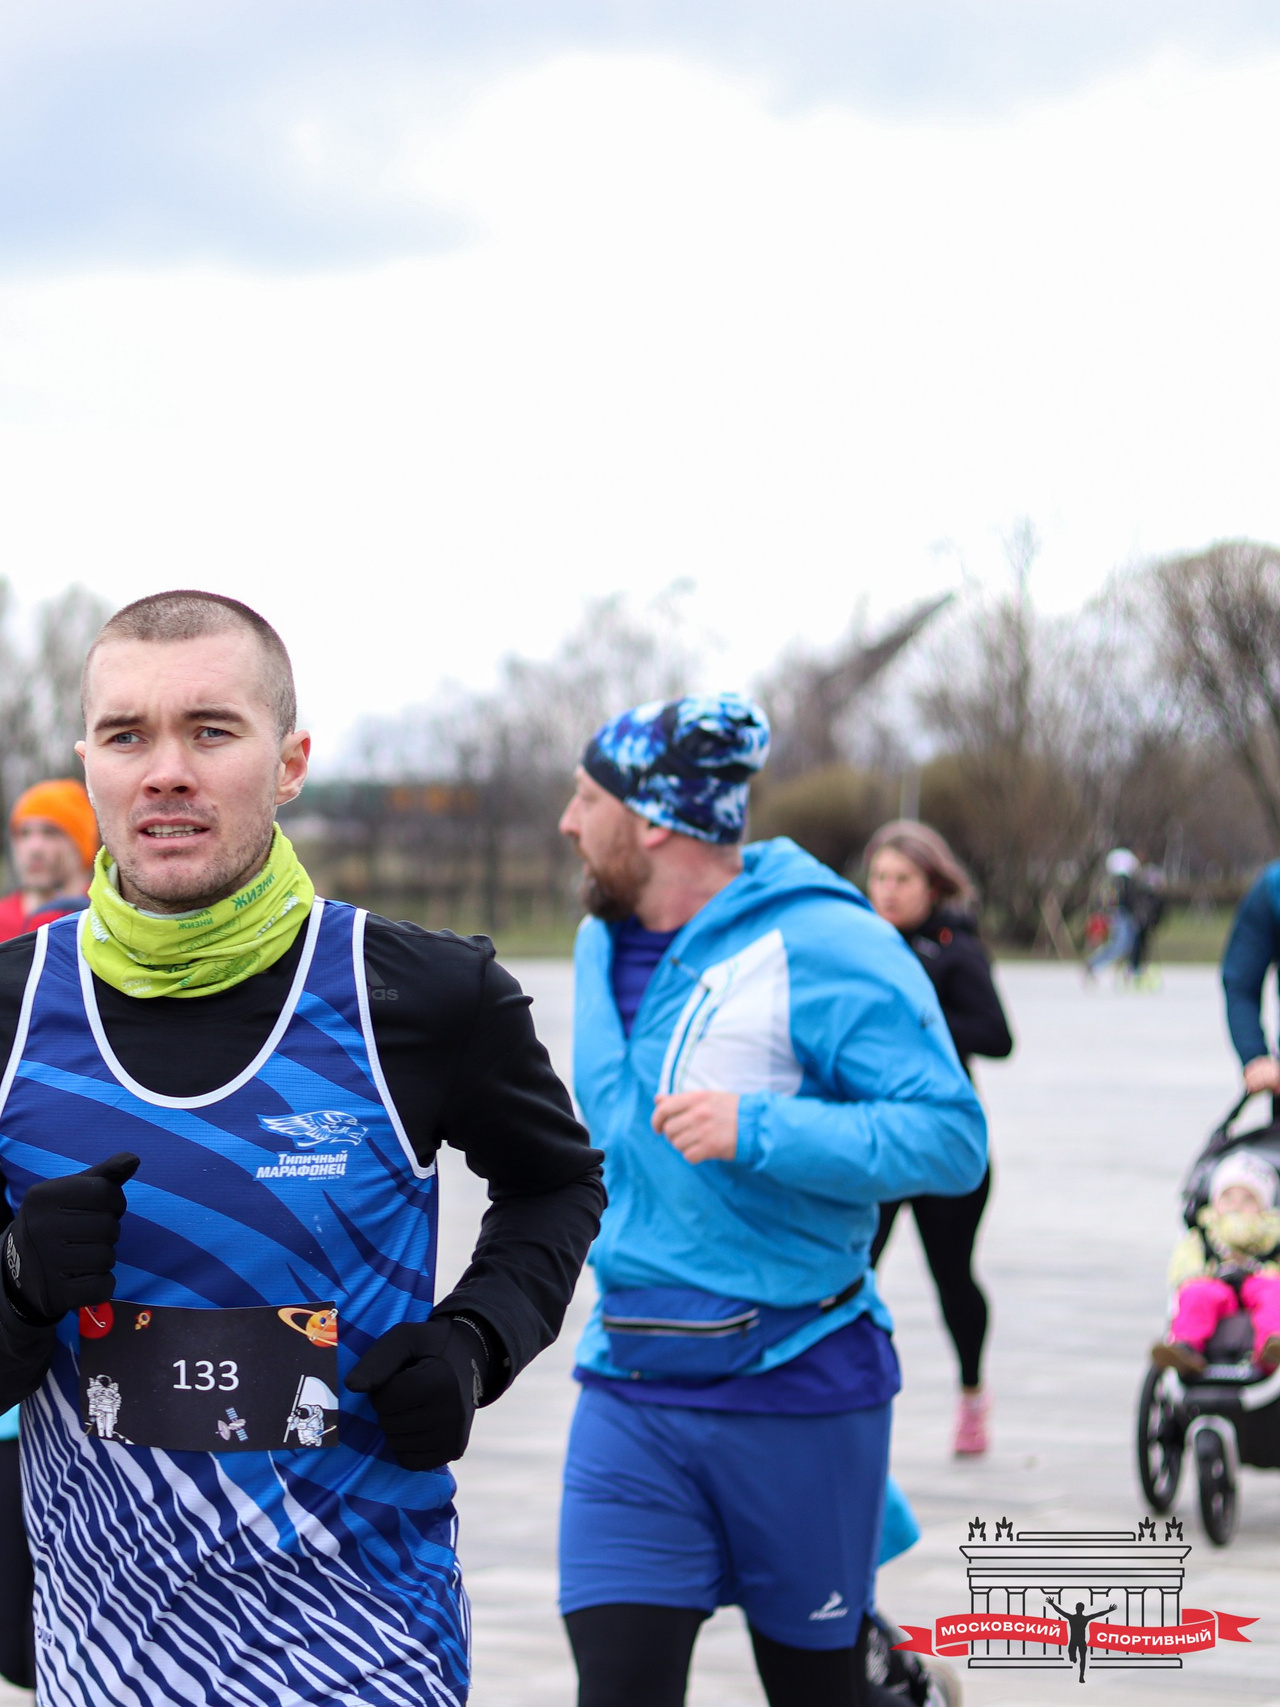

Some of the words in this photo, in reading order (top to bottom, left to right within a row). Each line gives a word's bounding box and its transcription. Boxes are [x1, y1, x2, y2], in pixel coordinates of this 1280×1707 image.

[231, 873, 275, 911] ЖИЗНИ
[255, 1163, 347, 1179] МАРАФОНЕЦ
[172, 1359, 240, 1391] 133
